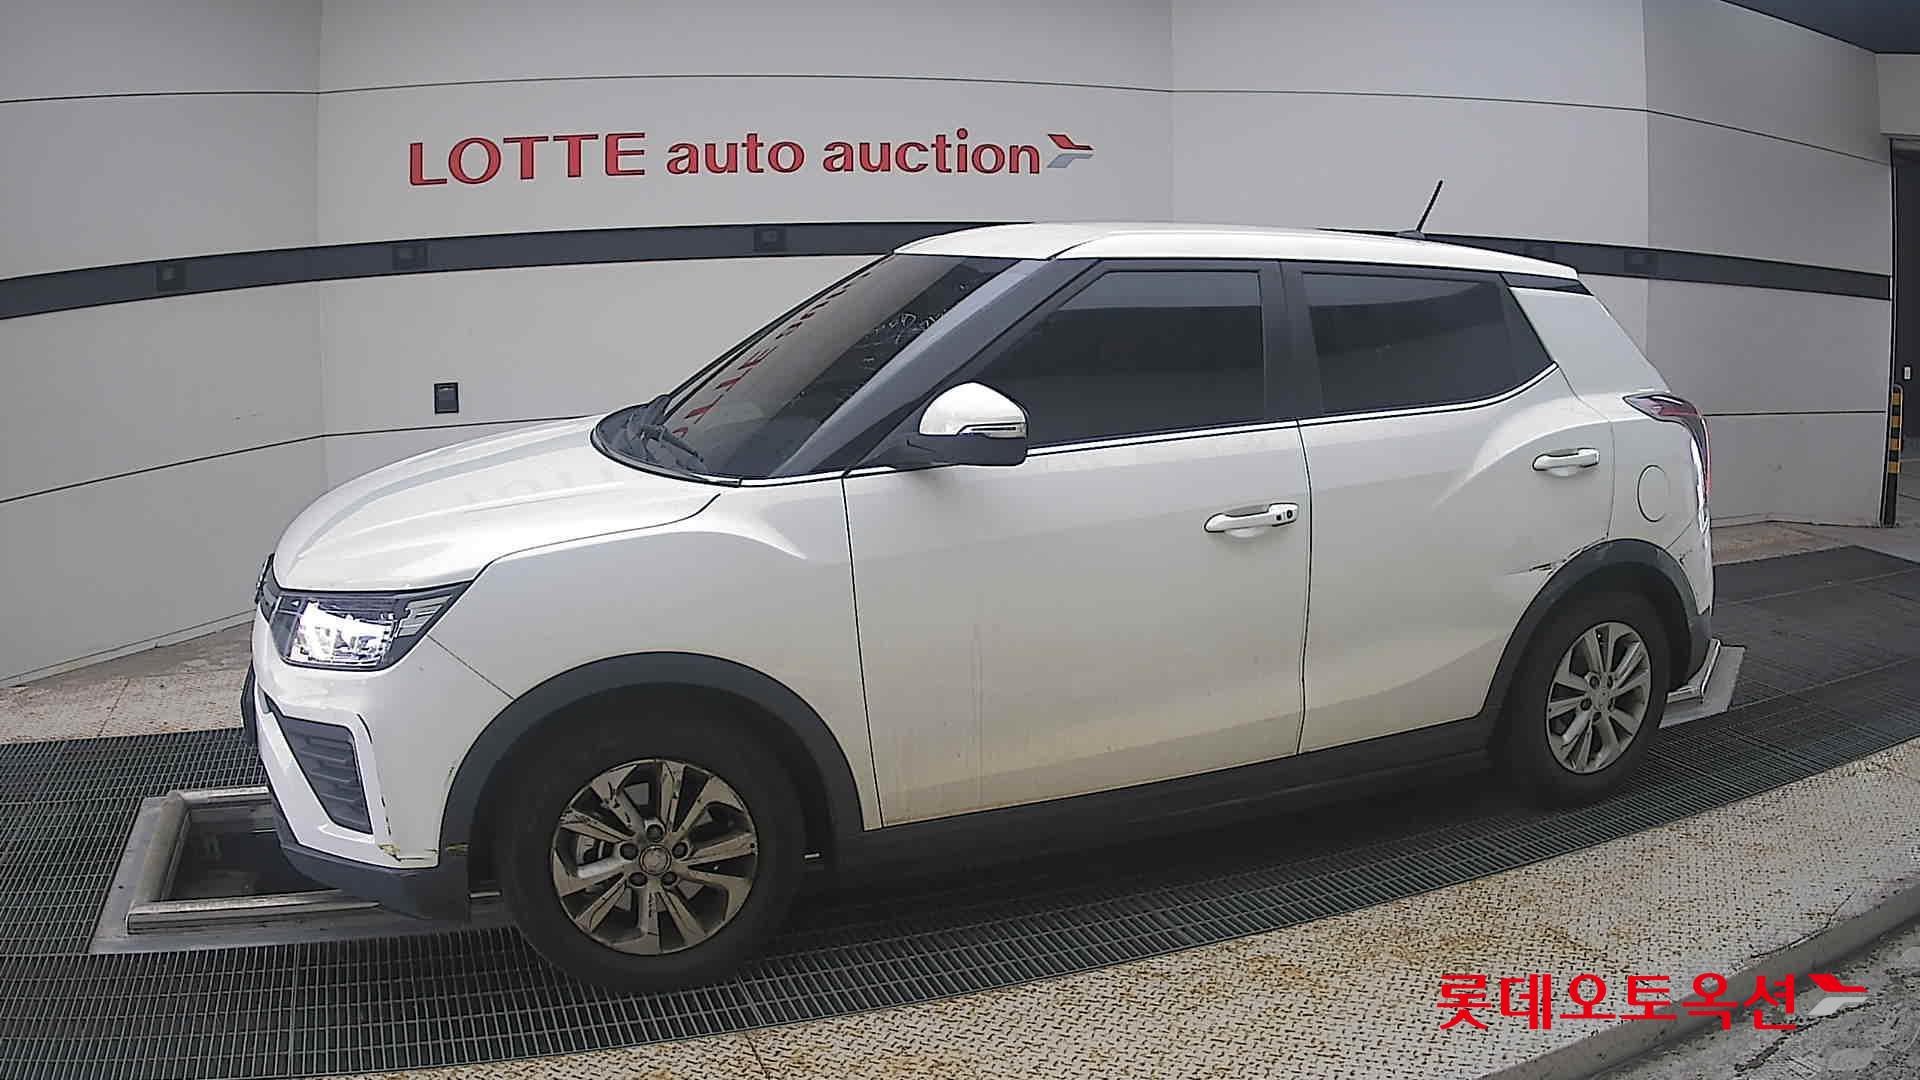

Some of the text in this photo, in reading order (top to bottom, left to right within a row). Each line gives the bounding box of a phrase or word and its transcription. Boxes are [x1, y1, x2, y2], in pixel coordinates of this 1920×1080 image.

[409, 128, 1040, 186] LOTTE auto auction
